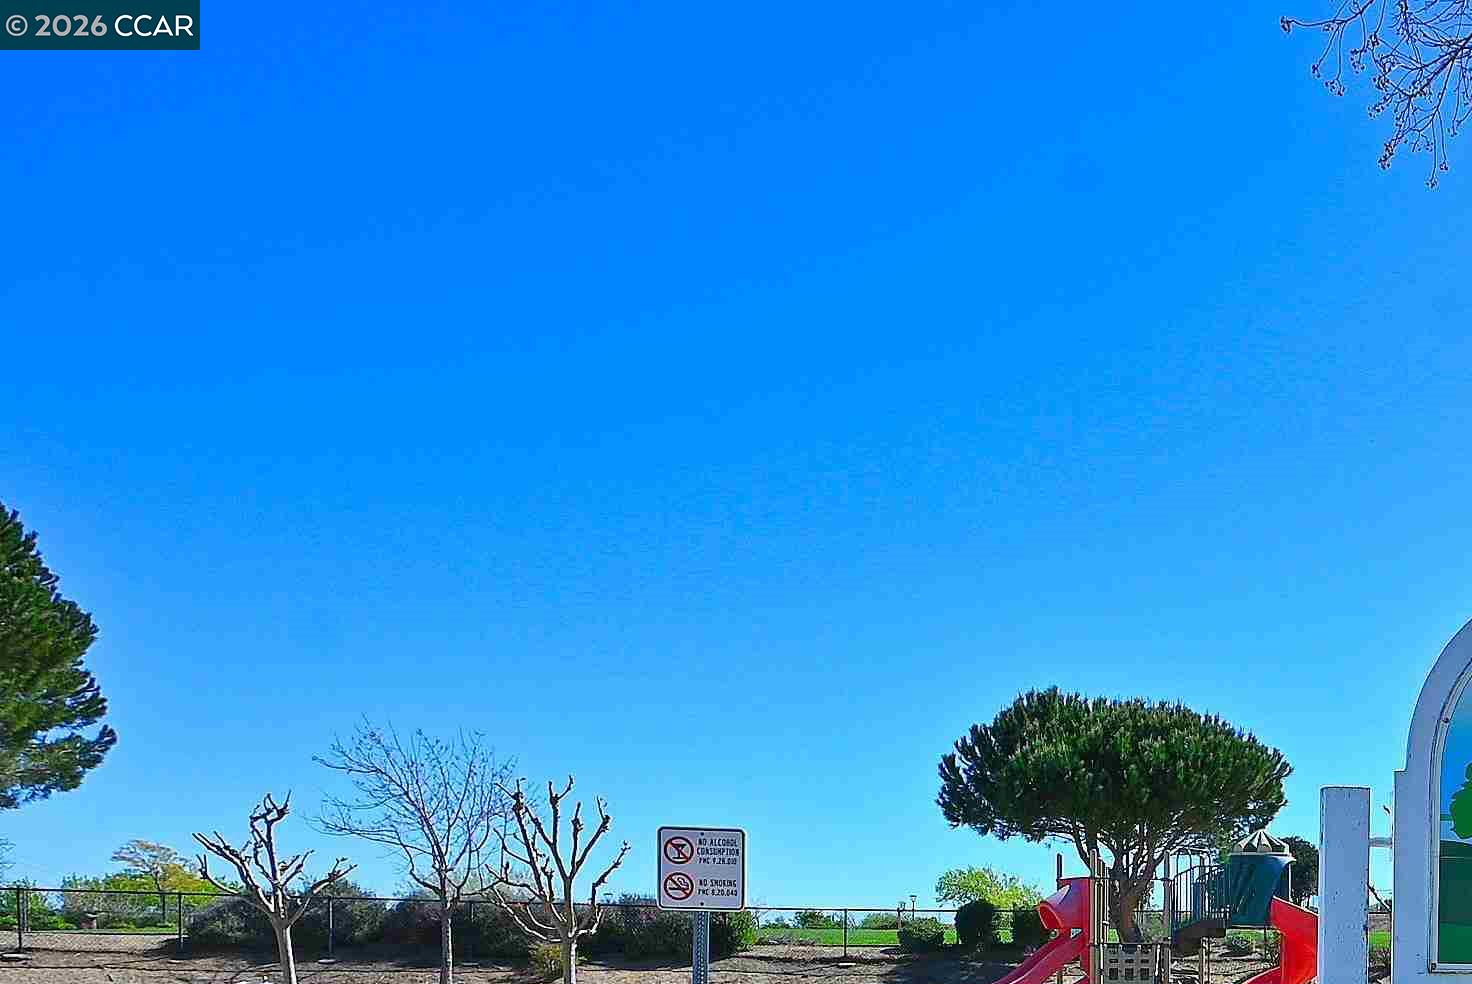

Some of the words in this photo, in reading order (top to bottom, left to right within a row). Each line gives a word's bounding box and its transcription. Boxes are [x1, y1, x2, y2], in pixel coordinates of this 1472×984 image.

[698, 838, 707, 847] NO
[710, 838, 738, 847] ALCOHOL
[696, 847, 739, 857] CONSUMPTION
[698, 879, 708, 887] NO
[710, 879, 737, 888] SMOKING
